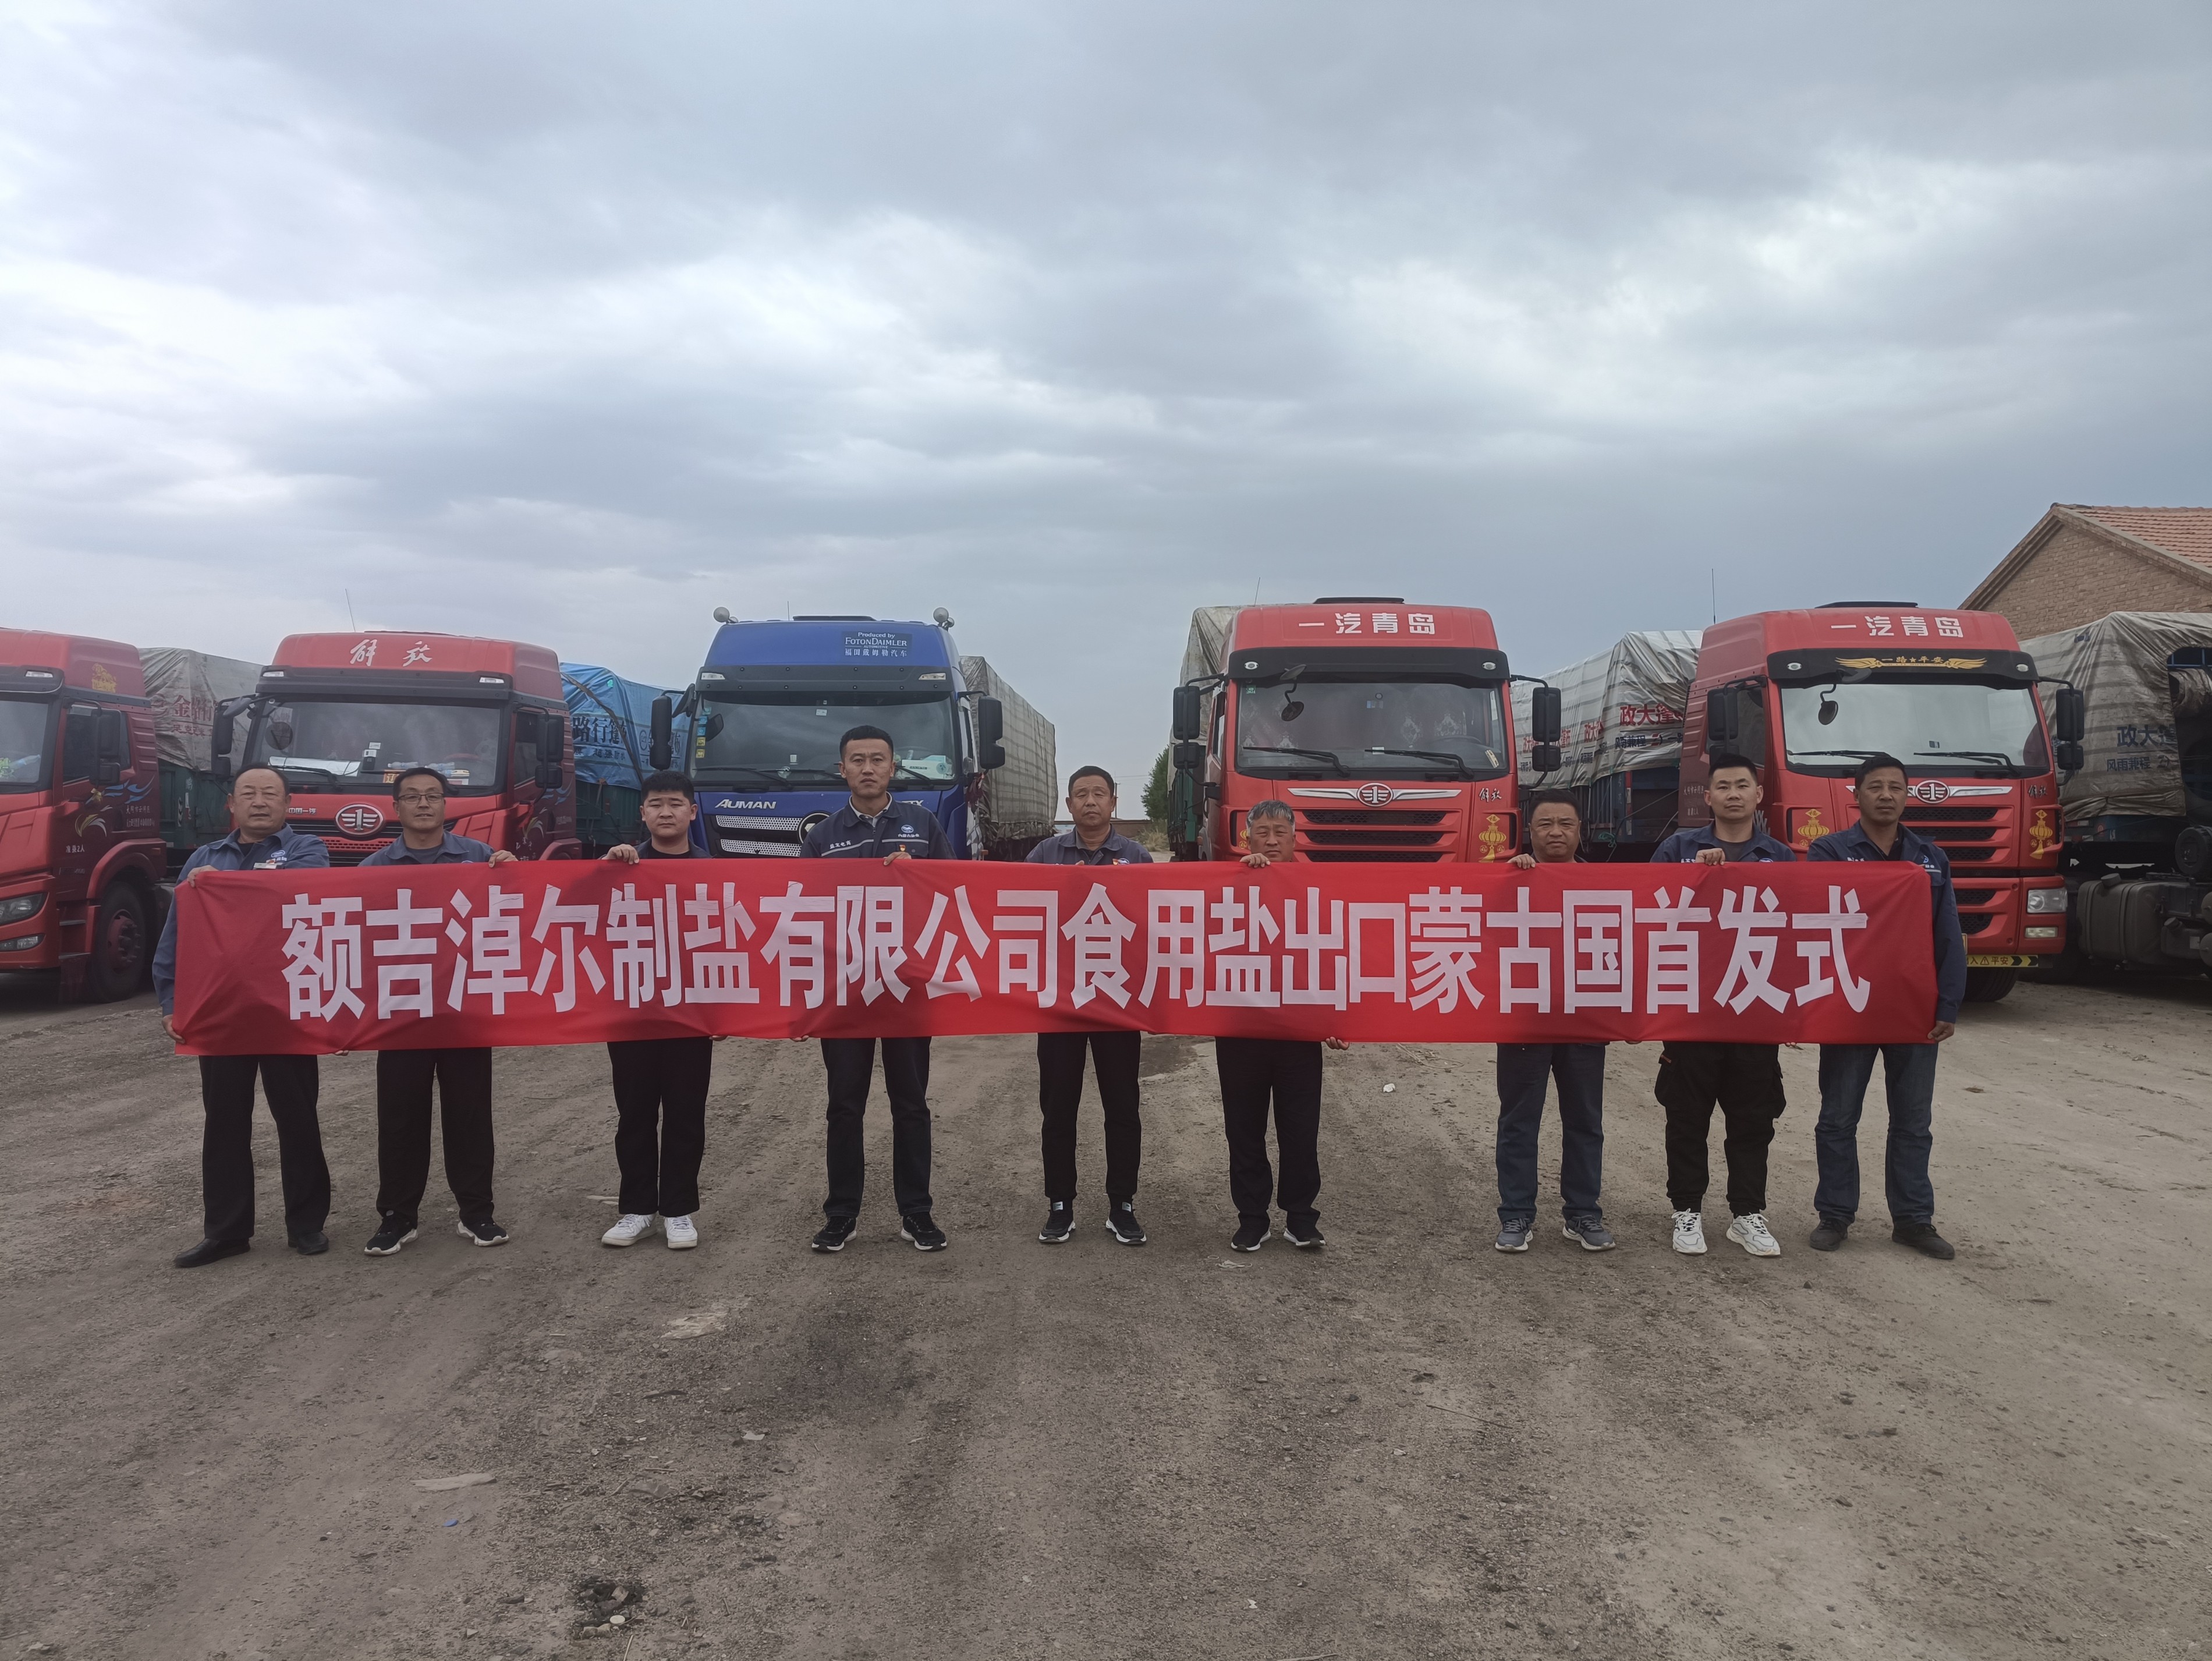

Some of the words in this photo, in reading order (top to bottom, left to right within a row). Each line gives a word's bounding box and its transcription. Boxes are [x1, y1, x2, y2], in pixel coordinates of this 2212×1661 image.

[1299, 612, 1435, 635] 一汽青岛
[1831, 616, 1963, 638] 一汽青岛
[858, 632, 886, 643] Produced
[888, 633, 895, 644] by
[350, 639, 433, 667] 解放
[845, 648, 907, 657] 福田戴姆勒汽车
[2107, 757, 2151, 772] 风雨兼程
[1479, 788, 1502, 802] 解放
[715, 799, 777, 809] AUMAN
[282, 881, 1870, 1022] 额吉淖尔制盐有限公司食用盐出口蒙古国首发式
[1991, 956, 2008, 965] 平安
